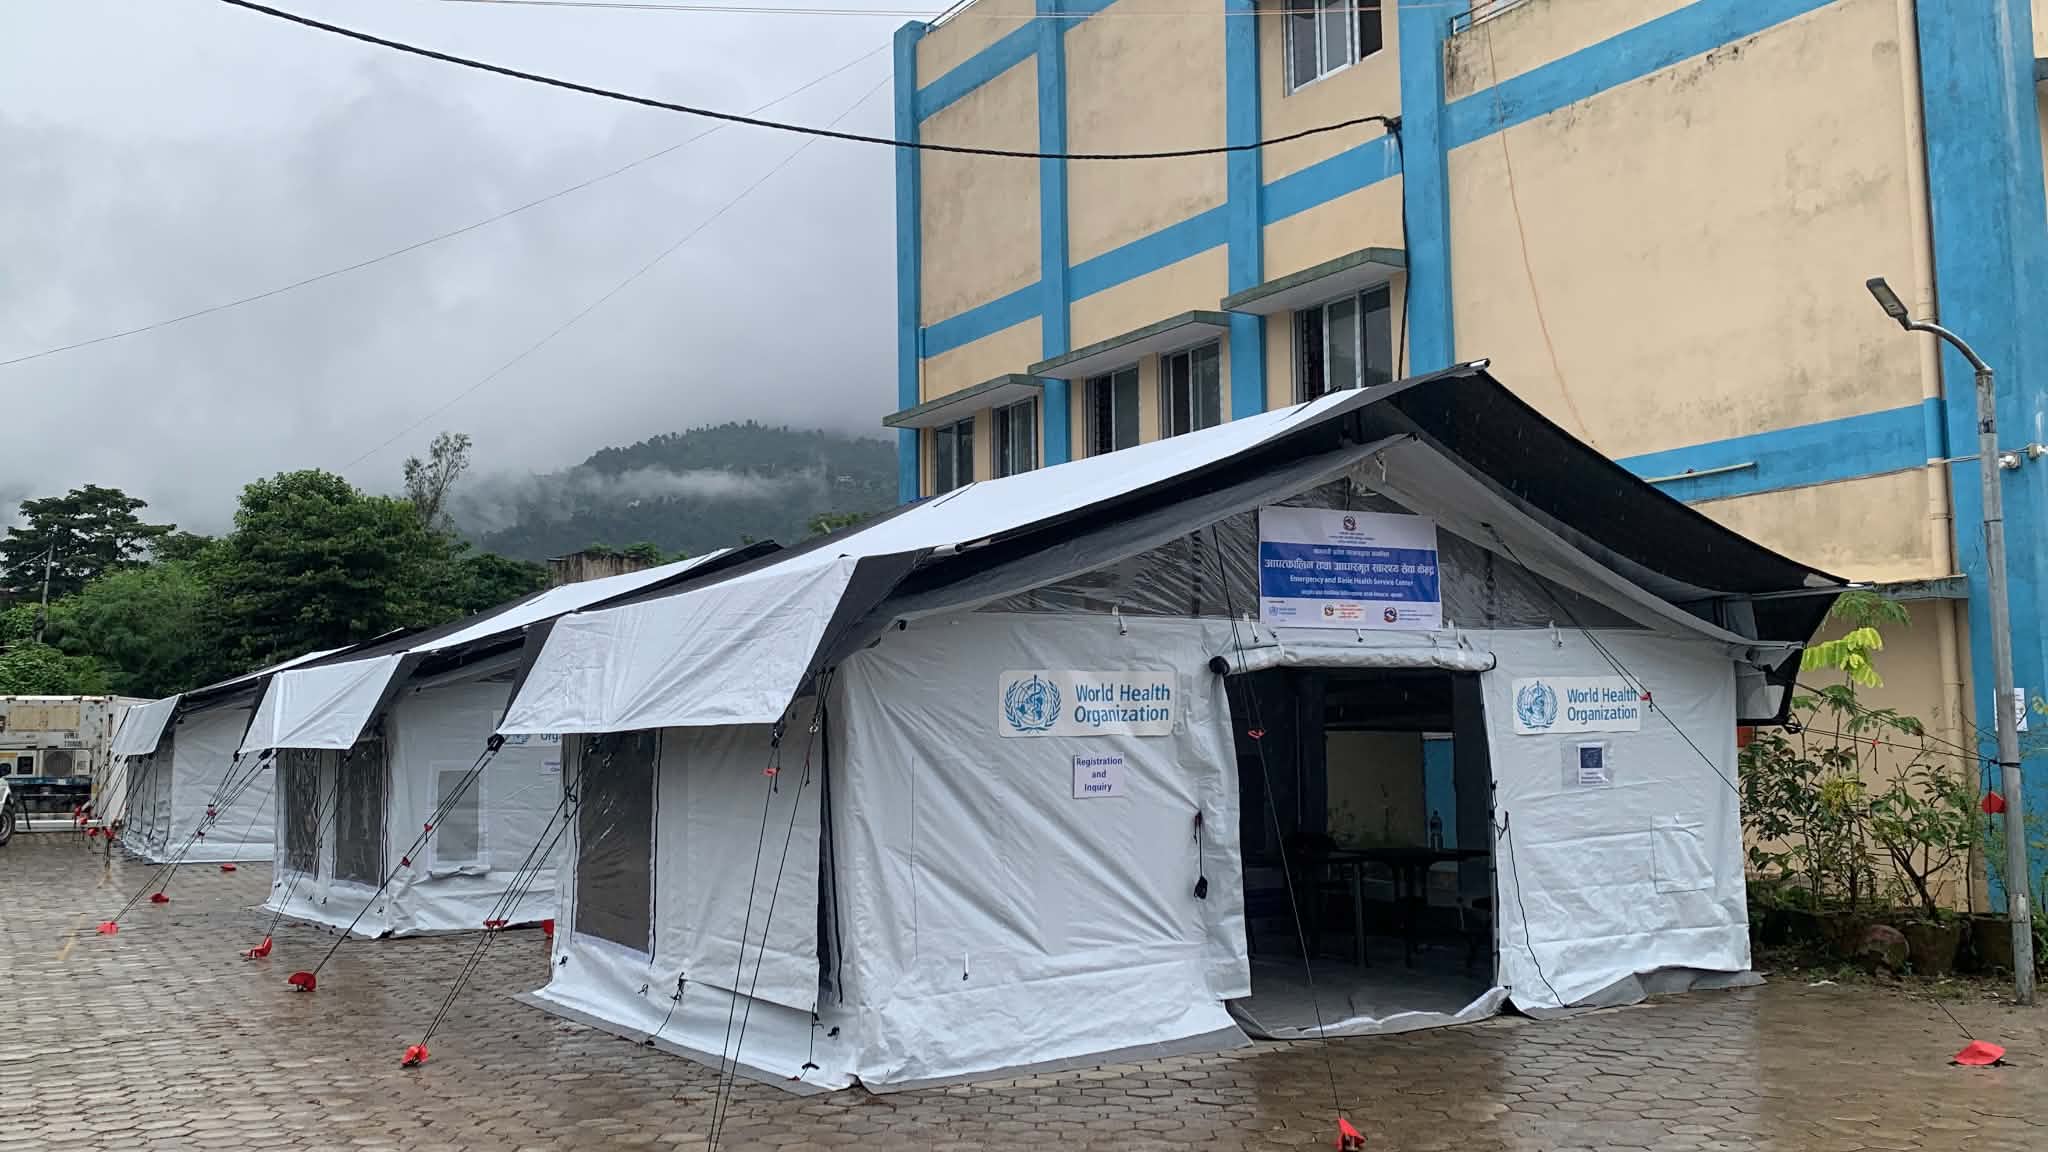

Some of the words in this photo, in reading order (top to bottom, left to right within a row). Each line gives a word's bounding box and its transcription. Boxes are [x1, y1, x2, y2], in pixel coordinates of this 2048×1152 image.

[1290, 575, 1324, 585] Emergency
[1324, 576, 1336, 584] and
[1338, 577, 1353, 585] Basic
[1354, 577, 1373, 585] Health
[1374, 577, 1394, 586] Service
[1076, 684, 1114, 702] World
[1119, 683, 1170, 702] Health
[1567, 687, 1599, 703] World
[1602, 686, 1637, 703] Health
[1074, 705, 1169, 726] Organization
[1567, 705, 1638, 725] Organization
[1076, 757, 1123, 768] Registration
[1092, 770, 1107, 779] and
[1084, 783, 1112, 793] Inquiry
